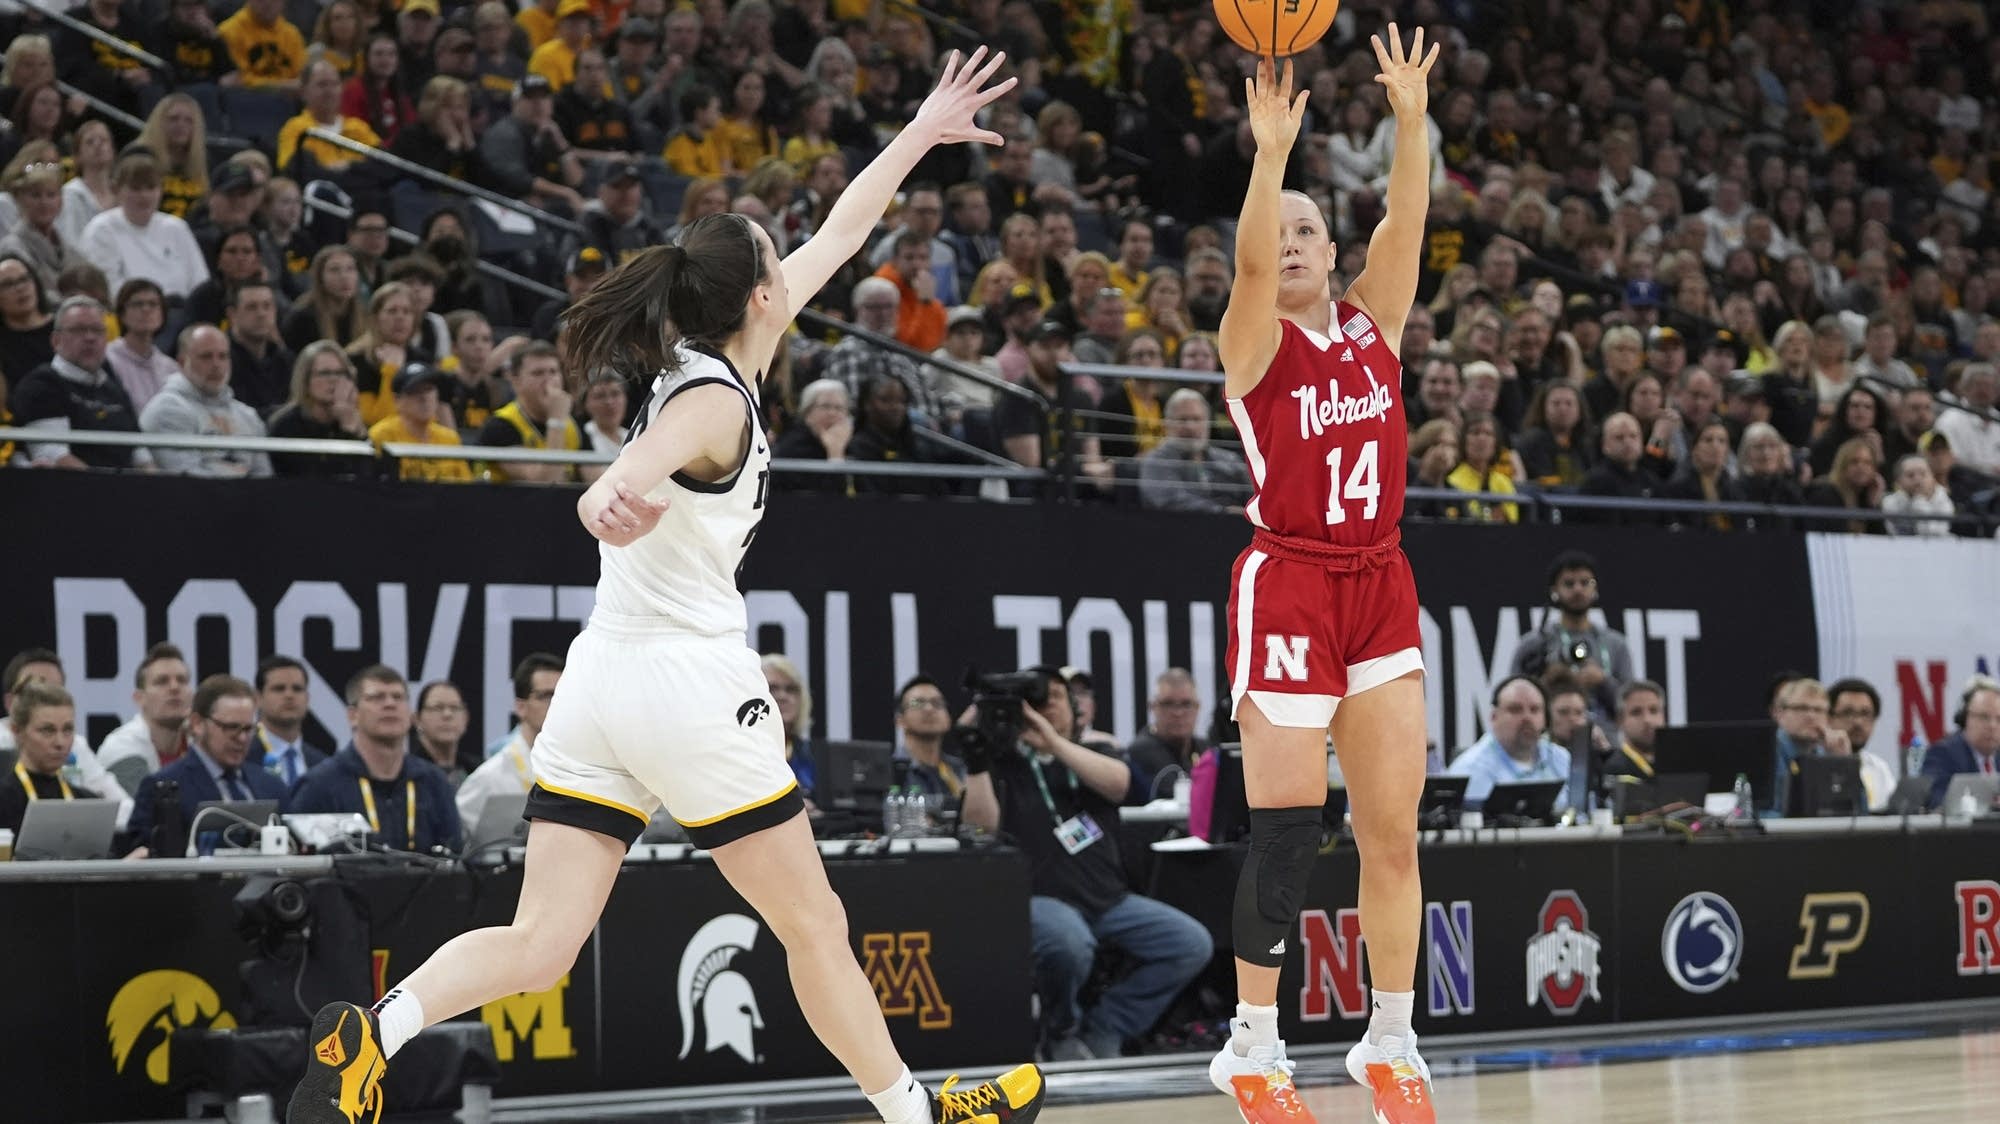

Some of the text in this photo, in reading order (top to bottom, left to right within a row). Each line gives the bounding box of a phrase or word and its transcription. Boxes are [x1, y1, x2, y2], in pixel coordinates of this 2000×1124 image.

[1291, 364, 1393, 440] Nebraska
[1325, 439, 1381, 526] 14
[1264, 633, 1310, 682] N
[1894, 656, 1949, 750] N
[1300, 908, 1369, 1022] N
[1426, 900, 1476, 1017] N
[1787, 890, 1871, 980] P
[1954, 879, 2000, 976] R
[863, 931, 953, 1030] M
